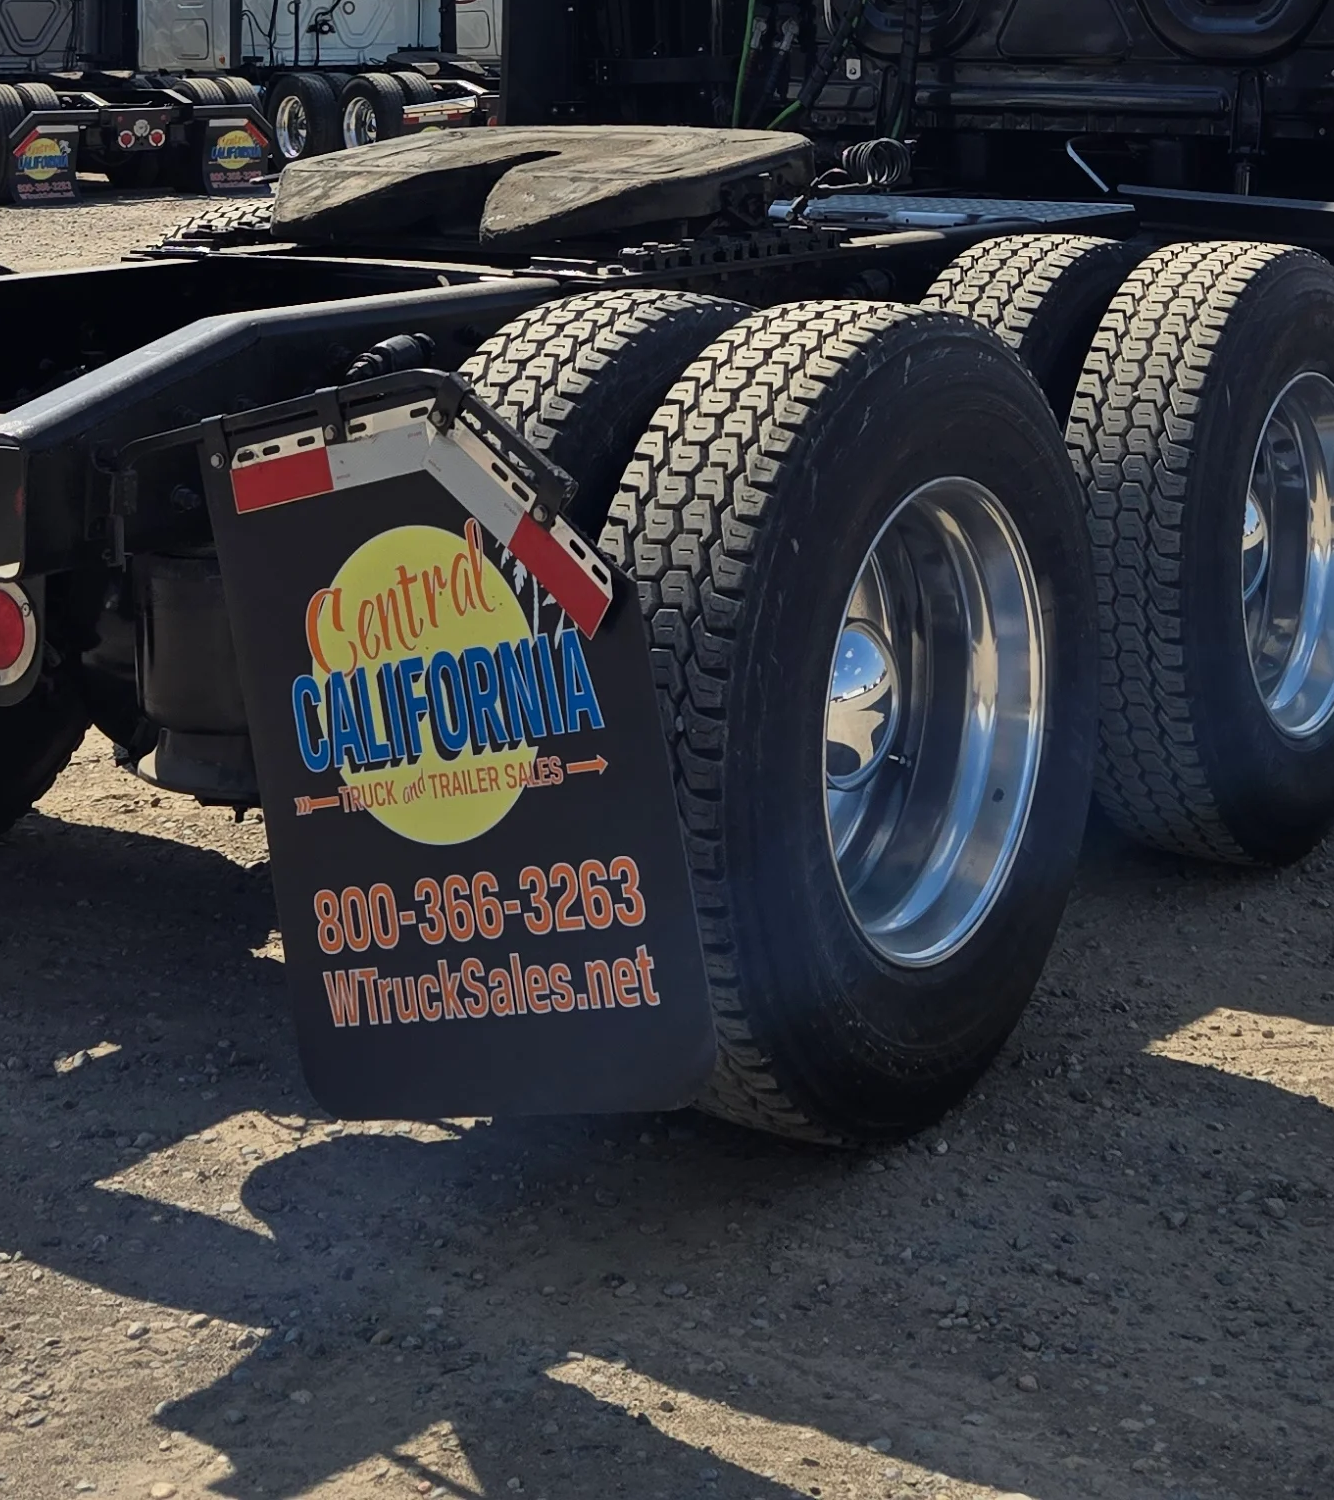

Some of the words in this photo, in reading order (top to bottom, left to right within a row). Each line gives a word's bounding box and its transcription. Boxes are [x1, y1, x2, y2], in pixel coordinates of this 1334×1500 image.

[305, 517, 497, 678] Central
[292, 627, 606, 774] CALIFORNIA
[338, 780, 398, 813] TRUCK
[402, 768, 428, 805] and
[428, 766, 500, 800] TRAILER
[504, 756, 564, 790] SALES
[314, 855, 646, 955] 800-366-3263
[322, 943, 662, 1028] WTruckSales.net
